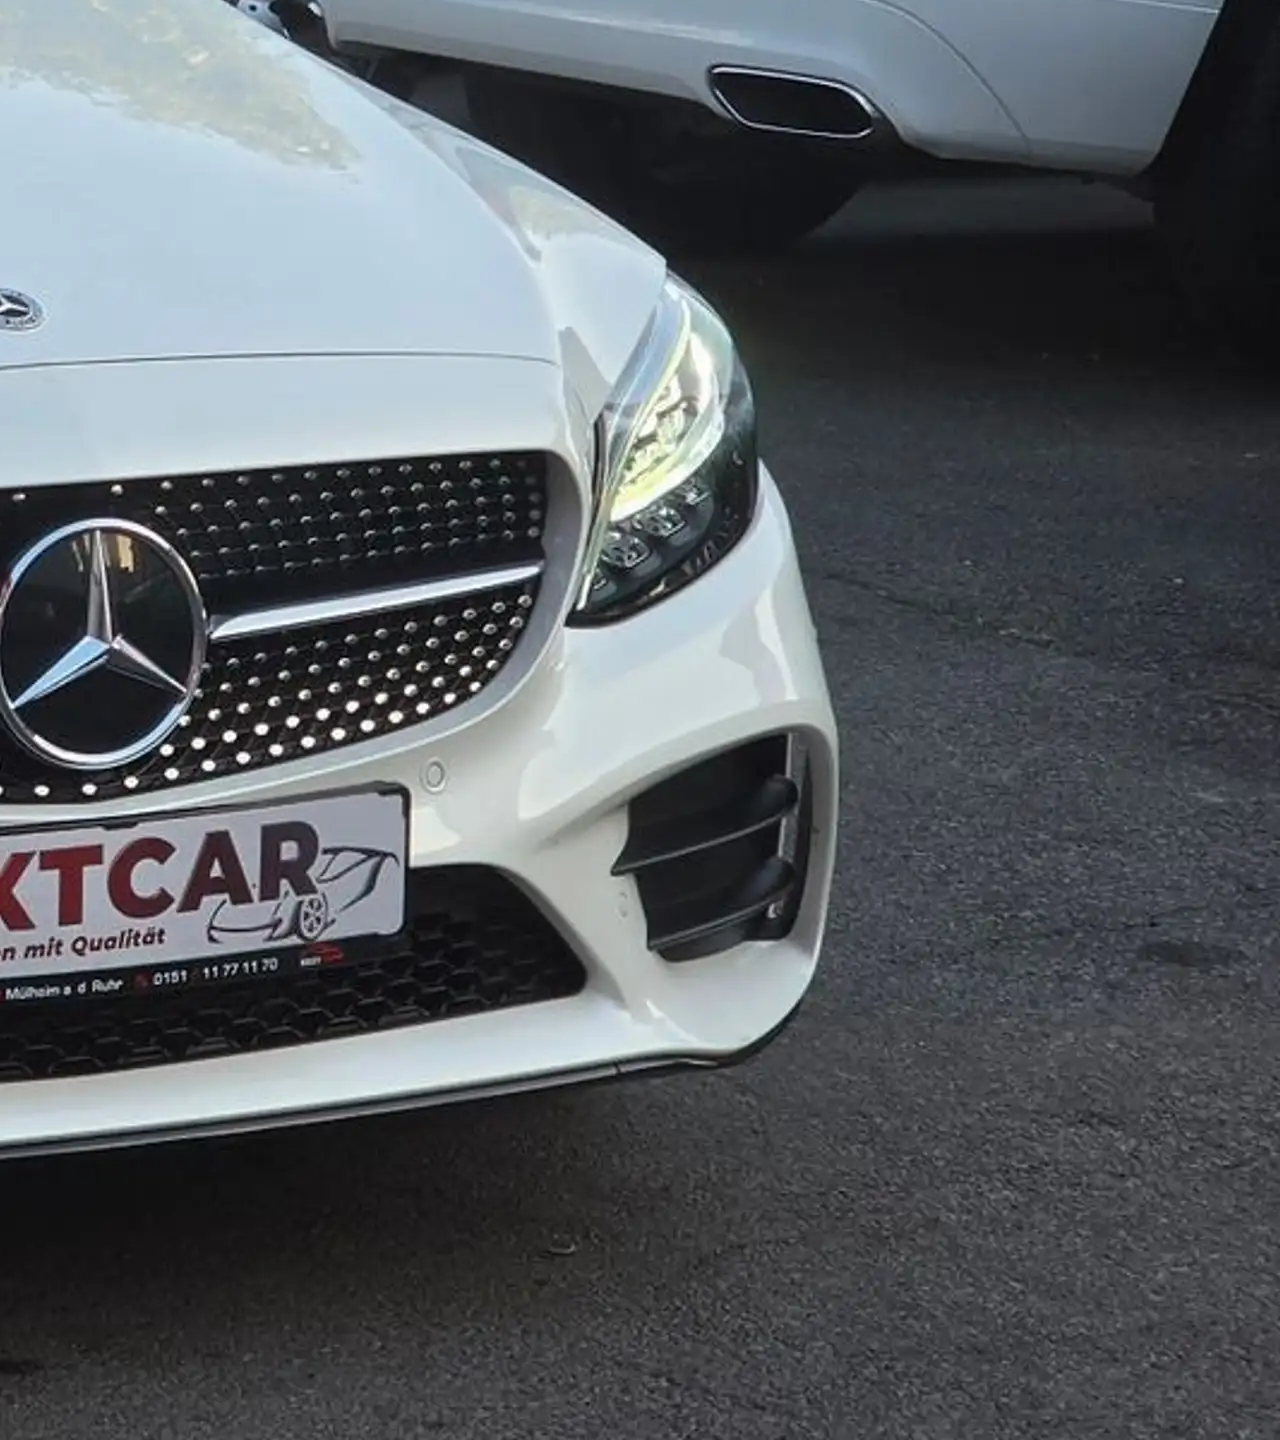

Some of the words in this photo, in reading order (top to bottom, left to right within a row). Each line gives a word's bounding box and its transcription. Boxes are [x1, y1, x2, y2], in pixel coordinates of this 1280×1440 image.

[23, 936, 64, 959] mit
[70, 927, 166, 957] Qualität
[92, 978, 124, 993] Ruhr
[153, 969, 188, 986] 0151
